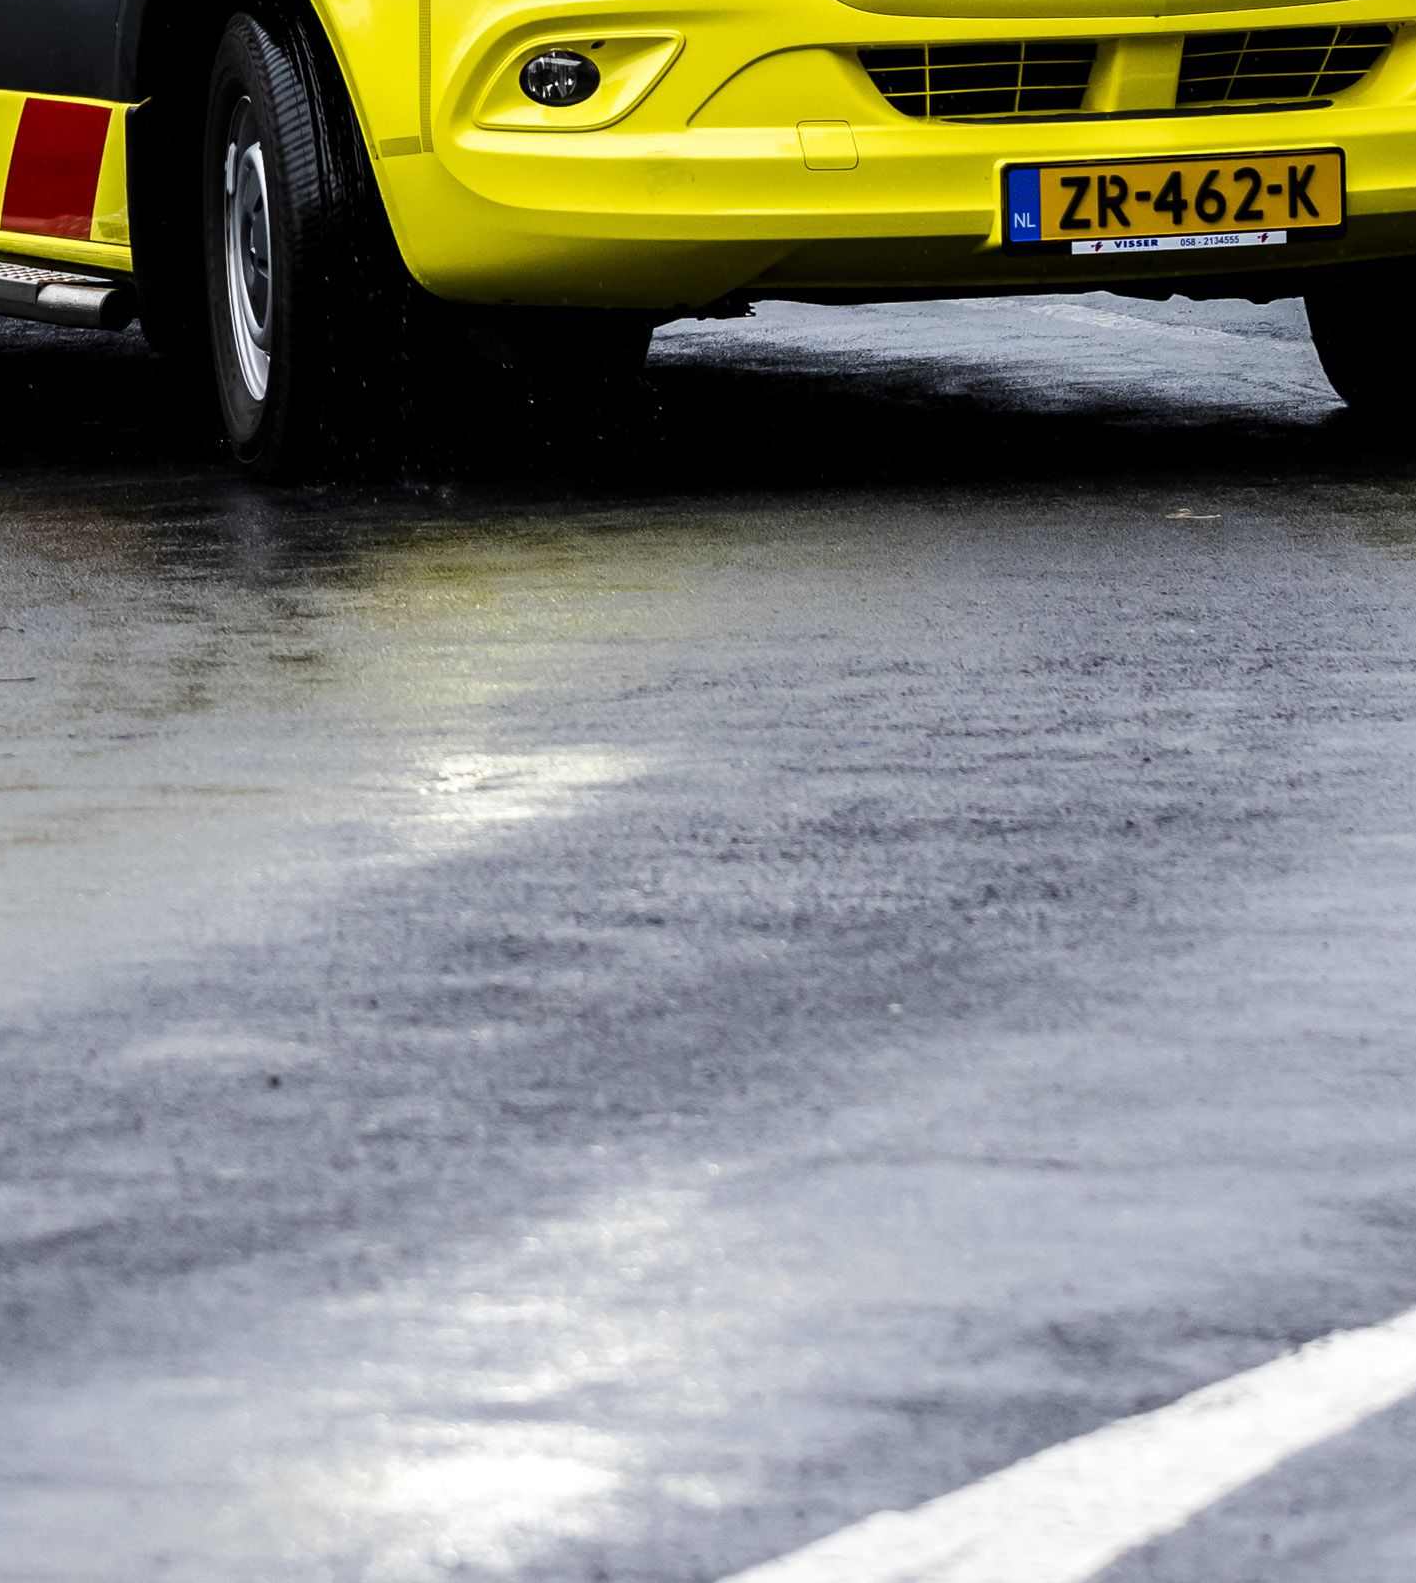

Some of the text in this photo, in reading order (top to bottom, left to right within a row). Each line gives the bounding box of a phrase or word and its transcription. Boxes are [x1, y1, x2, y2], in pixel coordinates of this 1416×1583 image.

[1058, 164, 1320, 231] ZR-462-K
[1013, 212, 1036, 229] NL
[1114, 239, 1159, 249] VISSER
[1180, 237, 1196, 247] 058
[1203, 235, 1240, 246] 2134555
